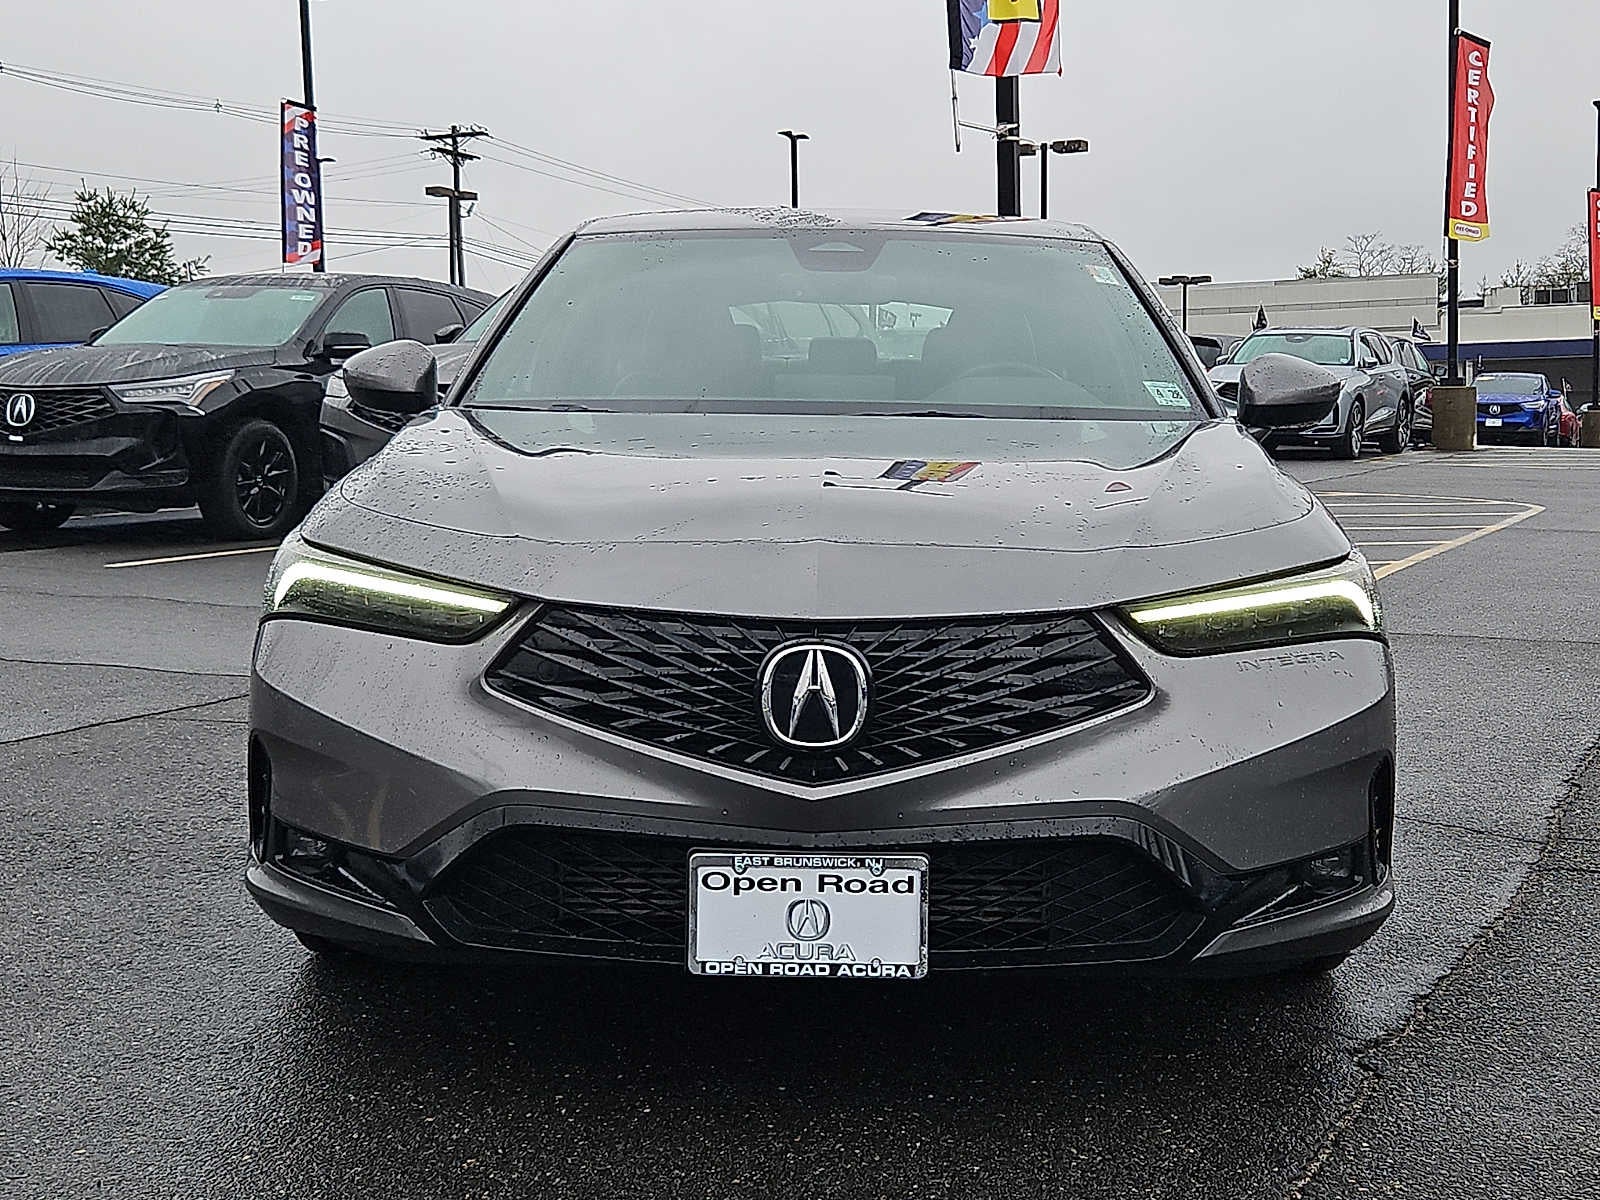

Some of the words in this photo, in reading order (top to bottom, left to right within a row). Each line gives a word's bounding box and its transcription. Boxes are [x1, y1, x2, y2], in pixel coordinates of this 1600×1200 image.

[293, 116, 309, 168] PRE
[1460, 50, 1483, 218] CERTIFIED
[291, 173, 316, 256] OWNED
[1236, 650, 1345, 672] INTEGRA
[734, 857, 770, 867] EAST
[775, 857, 861, 868] BRUNSWICK,
[865, 859, 883, 868] NJ
[701, 872, 802, 896] Open
[817, 875, 915, 894] Road
[756, 943, 856, 961] ACURA
[705, 961, 763, 975] OPEN
[769, 963, 830, 976] ROAD
[837, 964, 911, 977] ACURA
